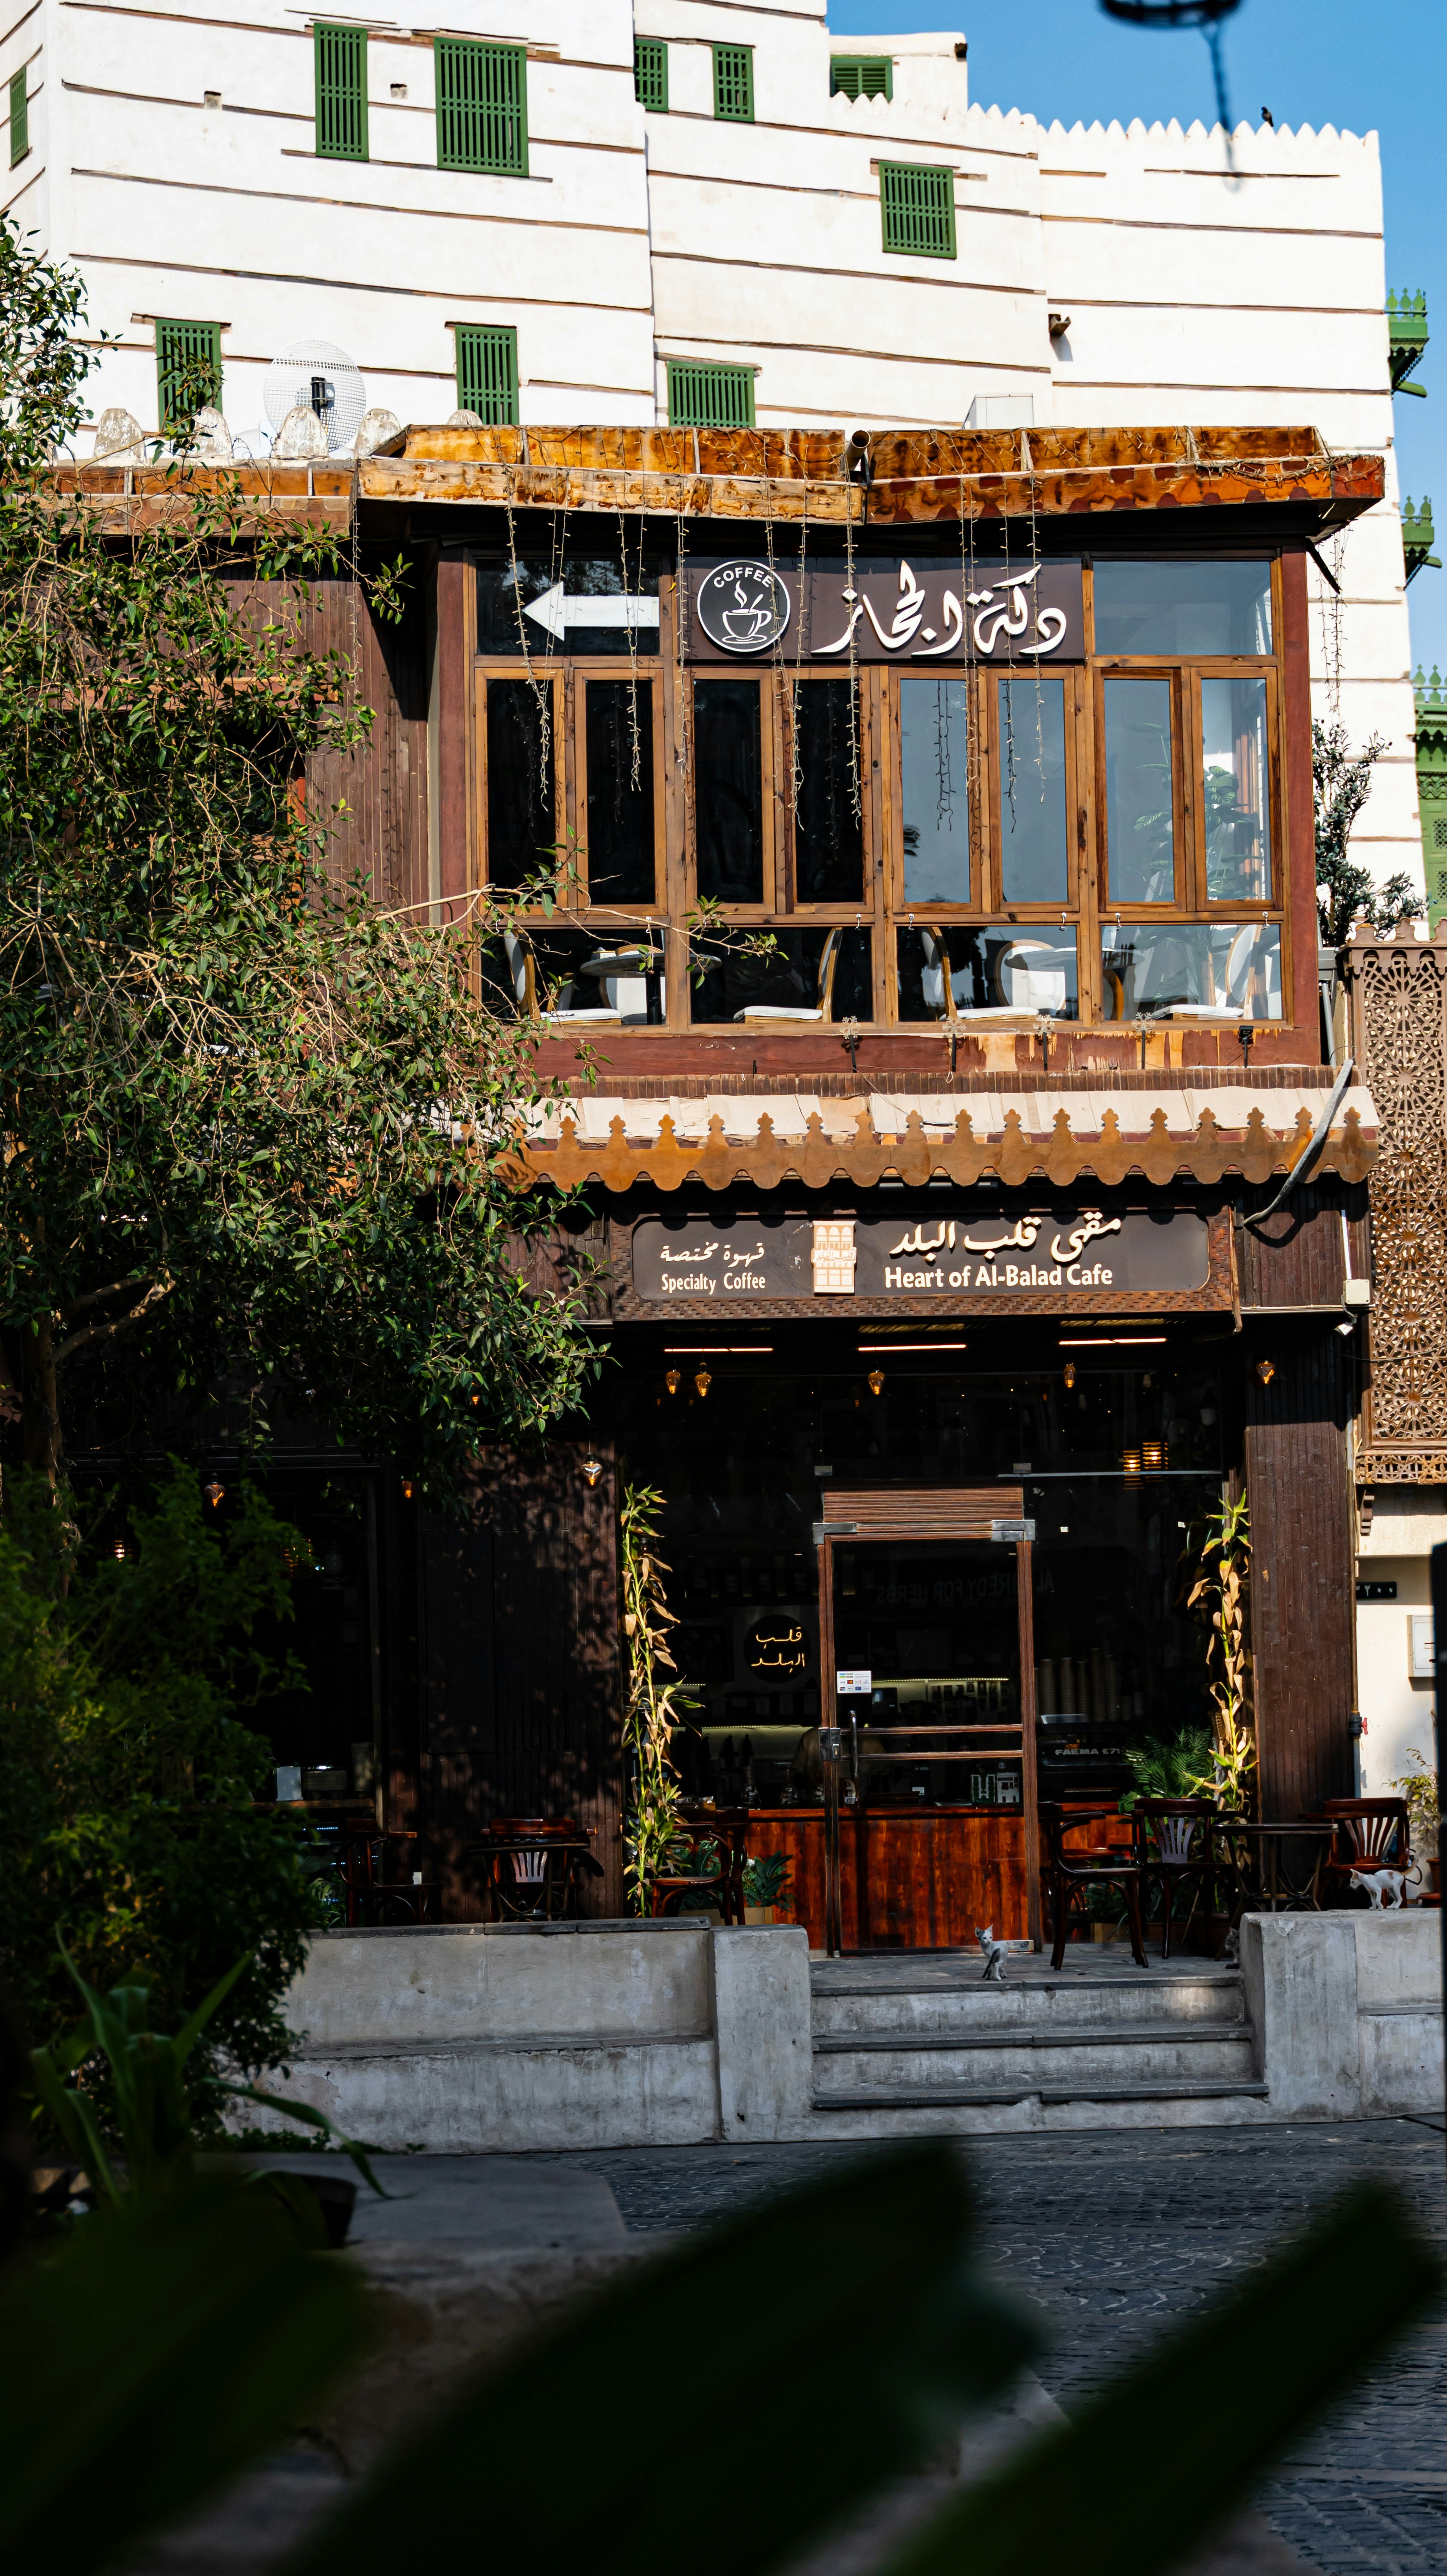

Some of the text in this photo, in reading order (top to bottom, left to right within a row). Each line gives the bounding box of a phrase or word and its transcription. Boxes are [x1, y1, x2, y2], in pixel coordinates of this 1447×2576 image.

[714, 567, 773, 588] COFFEE
[810, 560, 963, 655] الحجاز
[889, 1211, 1122, 1262] مقهى قلب البلد
[660, 1241, 764, 1268] قهوة مختصة
[662, 1272, 765, 1295] Specialty Coffee
[884, 1263, 1113, 1288] Heart of Al-Balad Cafe
[756, 1627, 802, 1649] قلب
[751, 1653, 805, 1673] البلد
